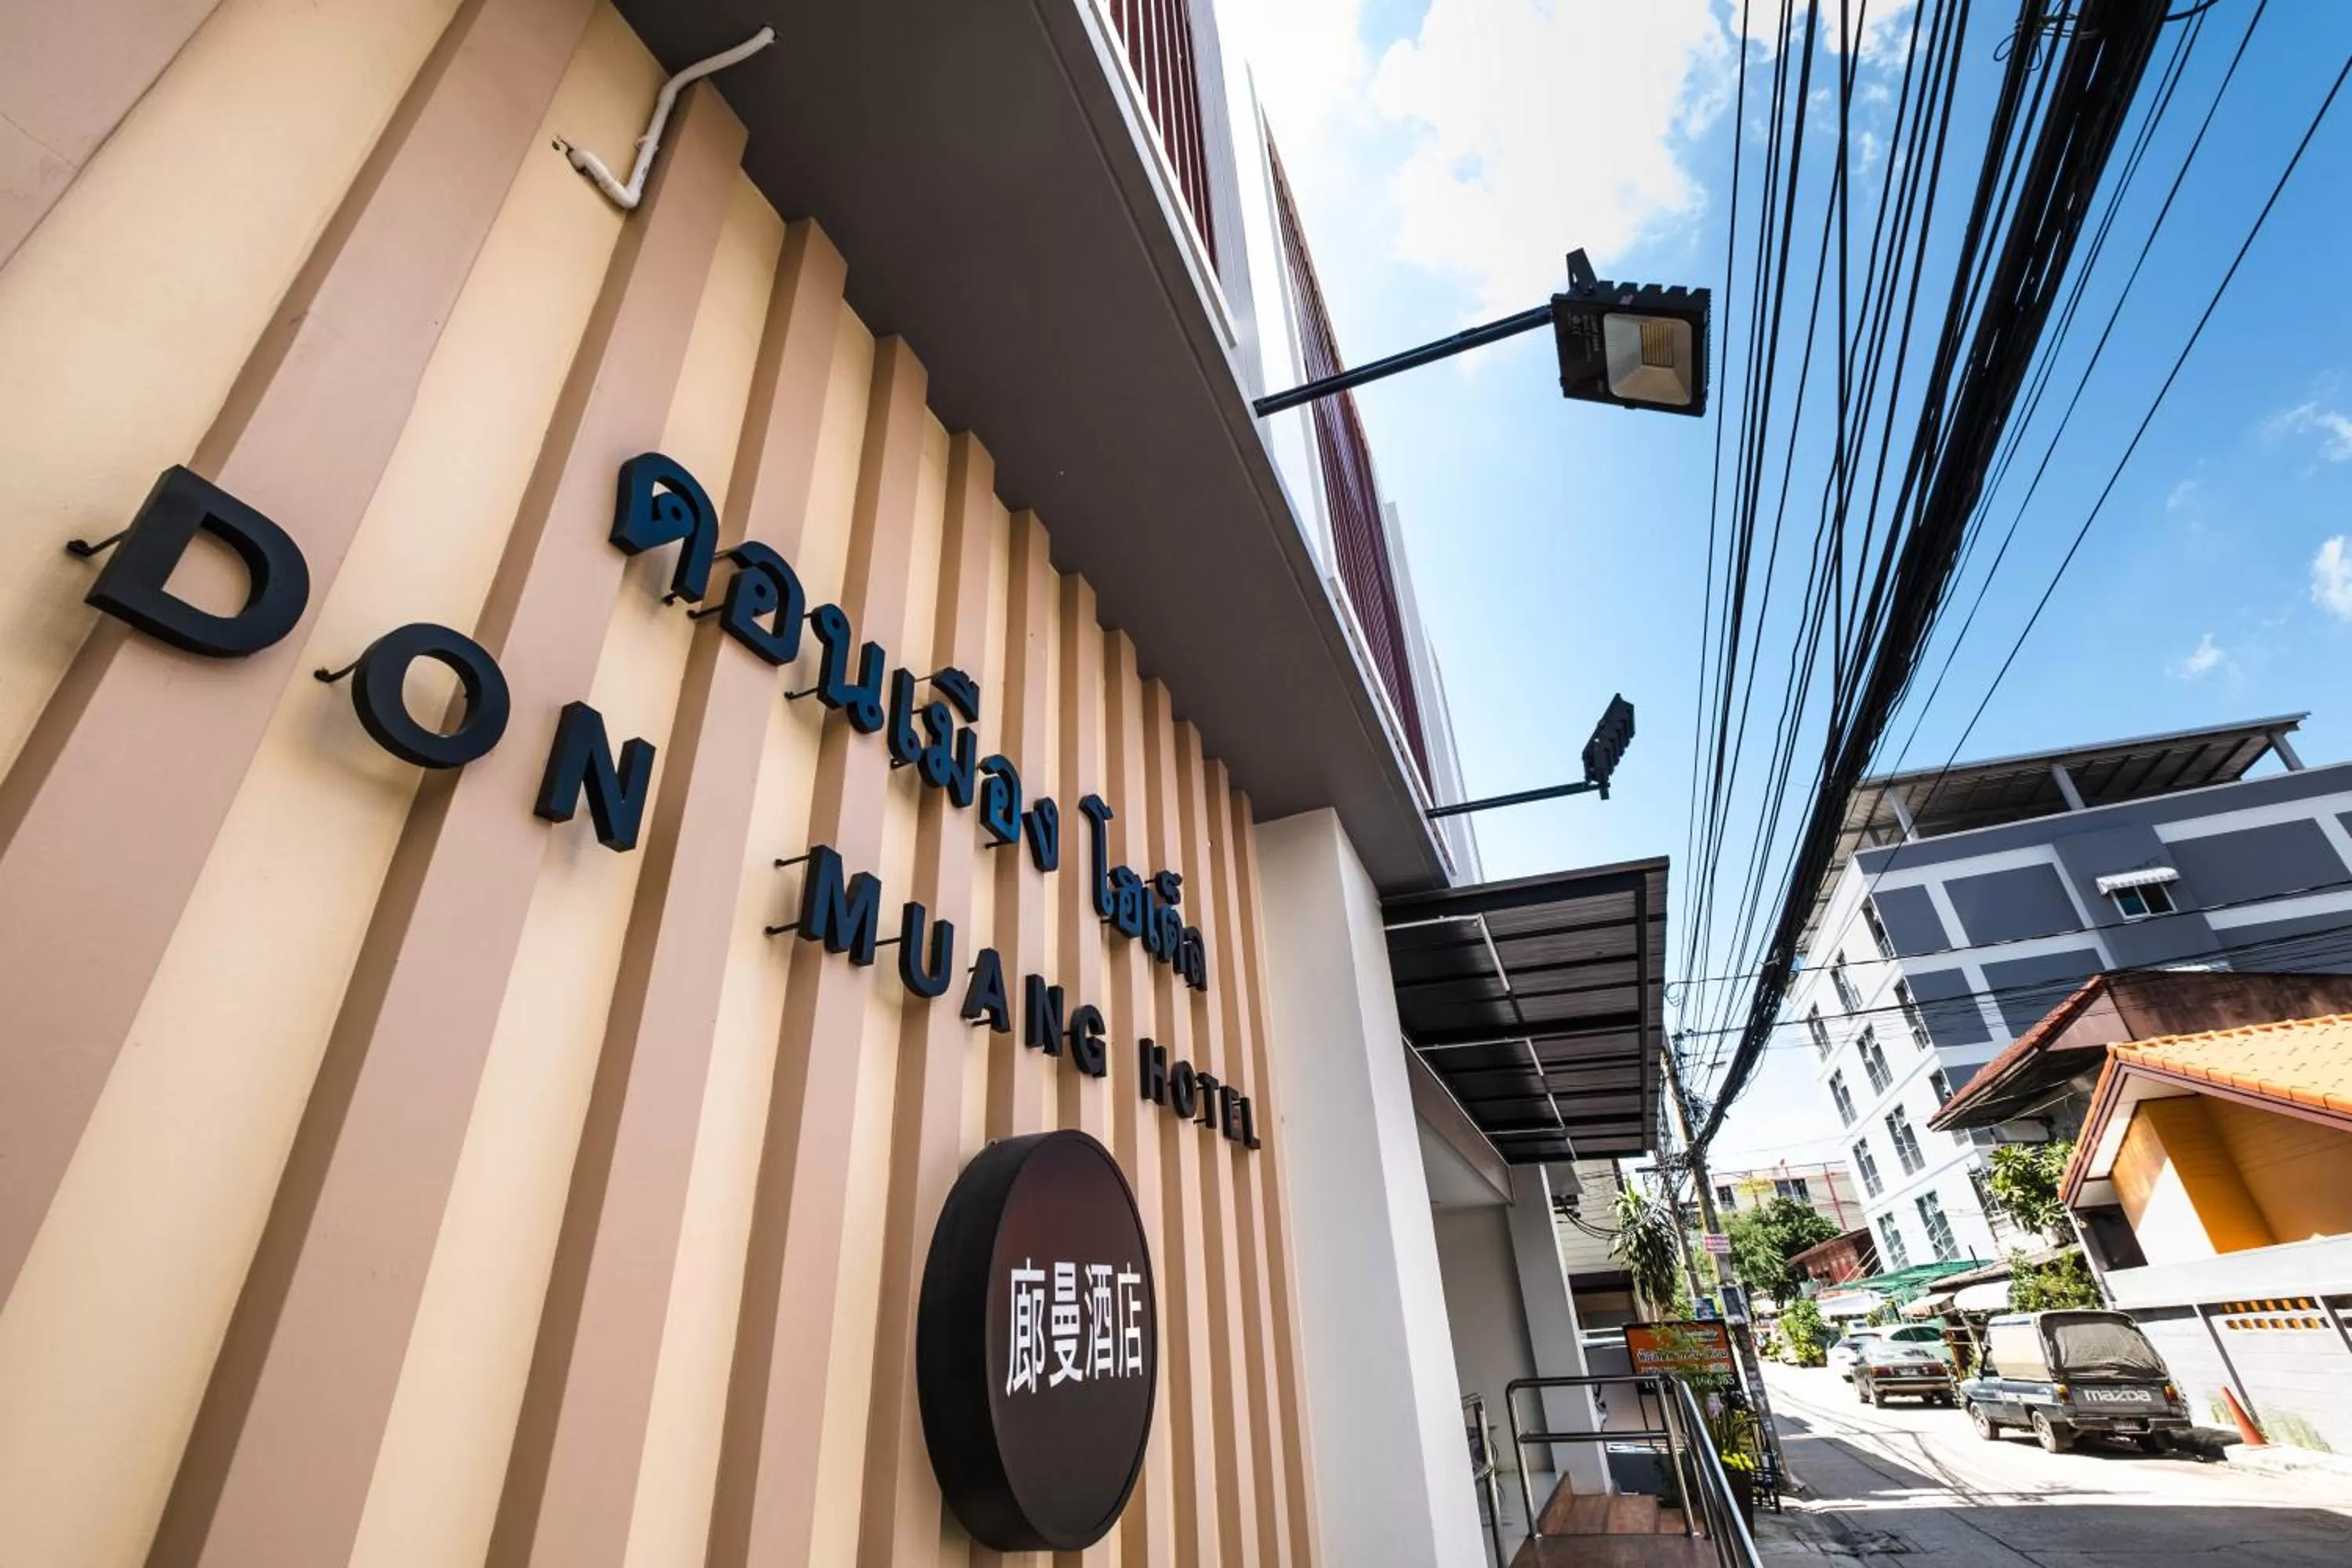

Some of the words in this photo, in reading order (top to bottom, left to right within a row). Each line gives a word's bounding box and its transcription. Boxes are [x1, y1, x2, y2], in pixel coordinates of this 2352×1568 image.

[84, 464, 655, 852] DON
[798, 844, 1107, 1078] MUANG
[1140, 1037, 1261, 1149] HOTEL
[608, 452, 1058, 873] ดอนเมือง
[1006, 1257, 1143, 1396] 廊曼酒店
